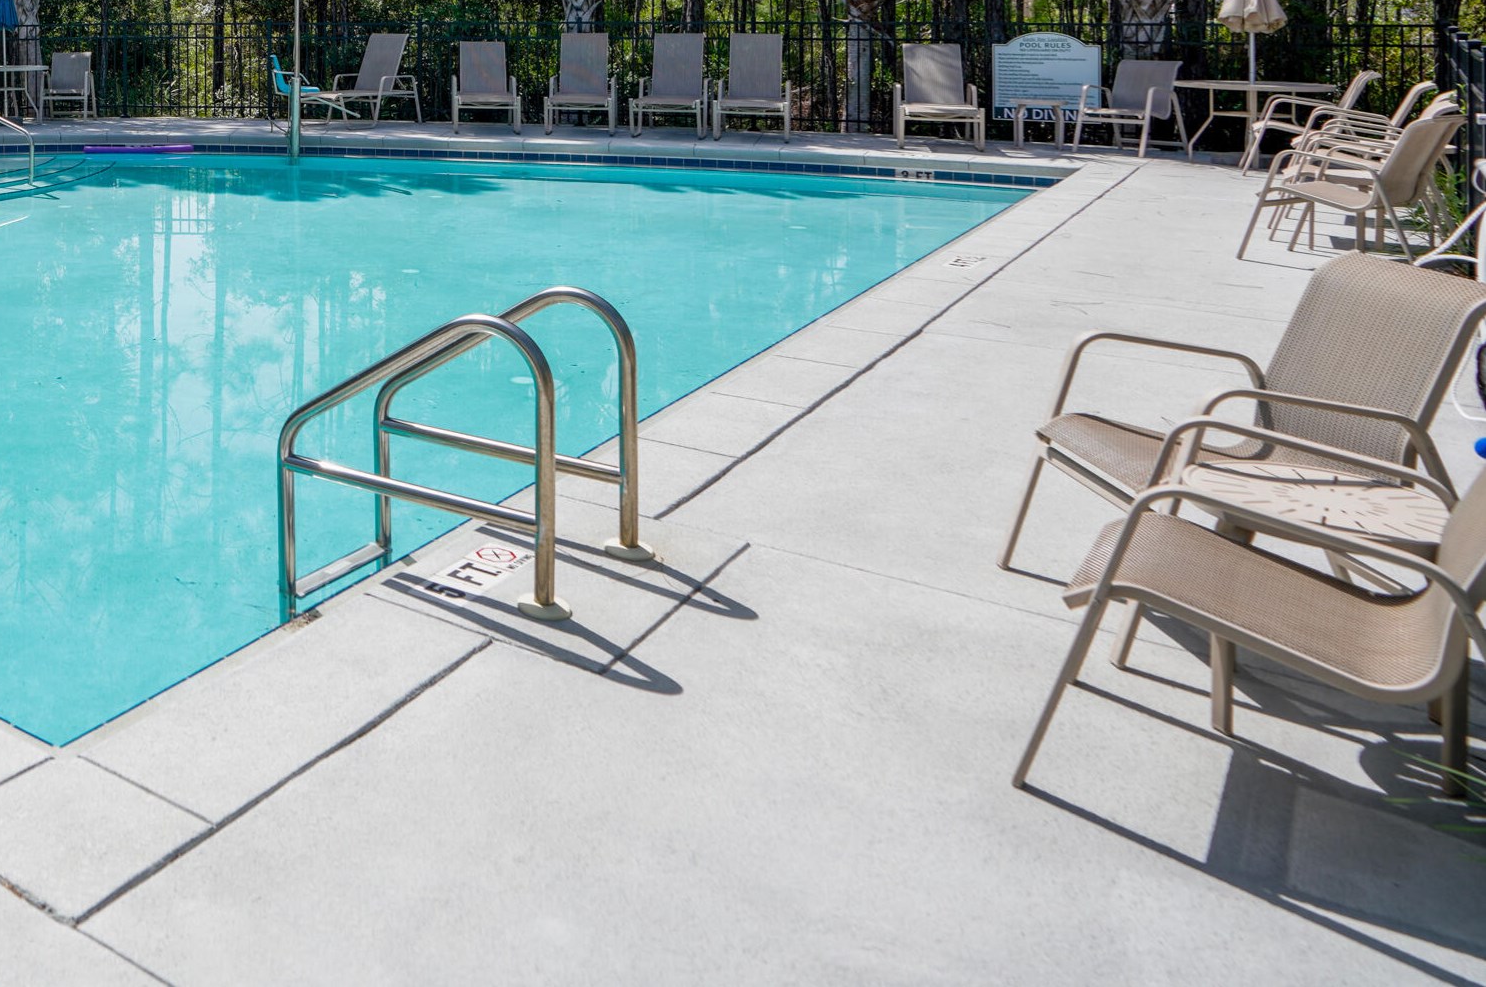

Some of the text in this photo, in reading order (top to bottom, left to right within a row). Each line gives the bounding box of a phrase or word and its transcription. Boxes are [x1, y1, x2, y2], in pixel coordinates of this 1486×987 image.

[916, 171, 932, 180] FT
[424, 562, 502, 598] 5 FT.
